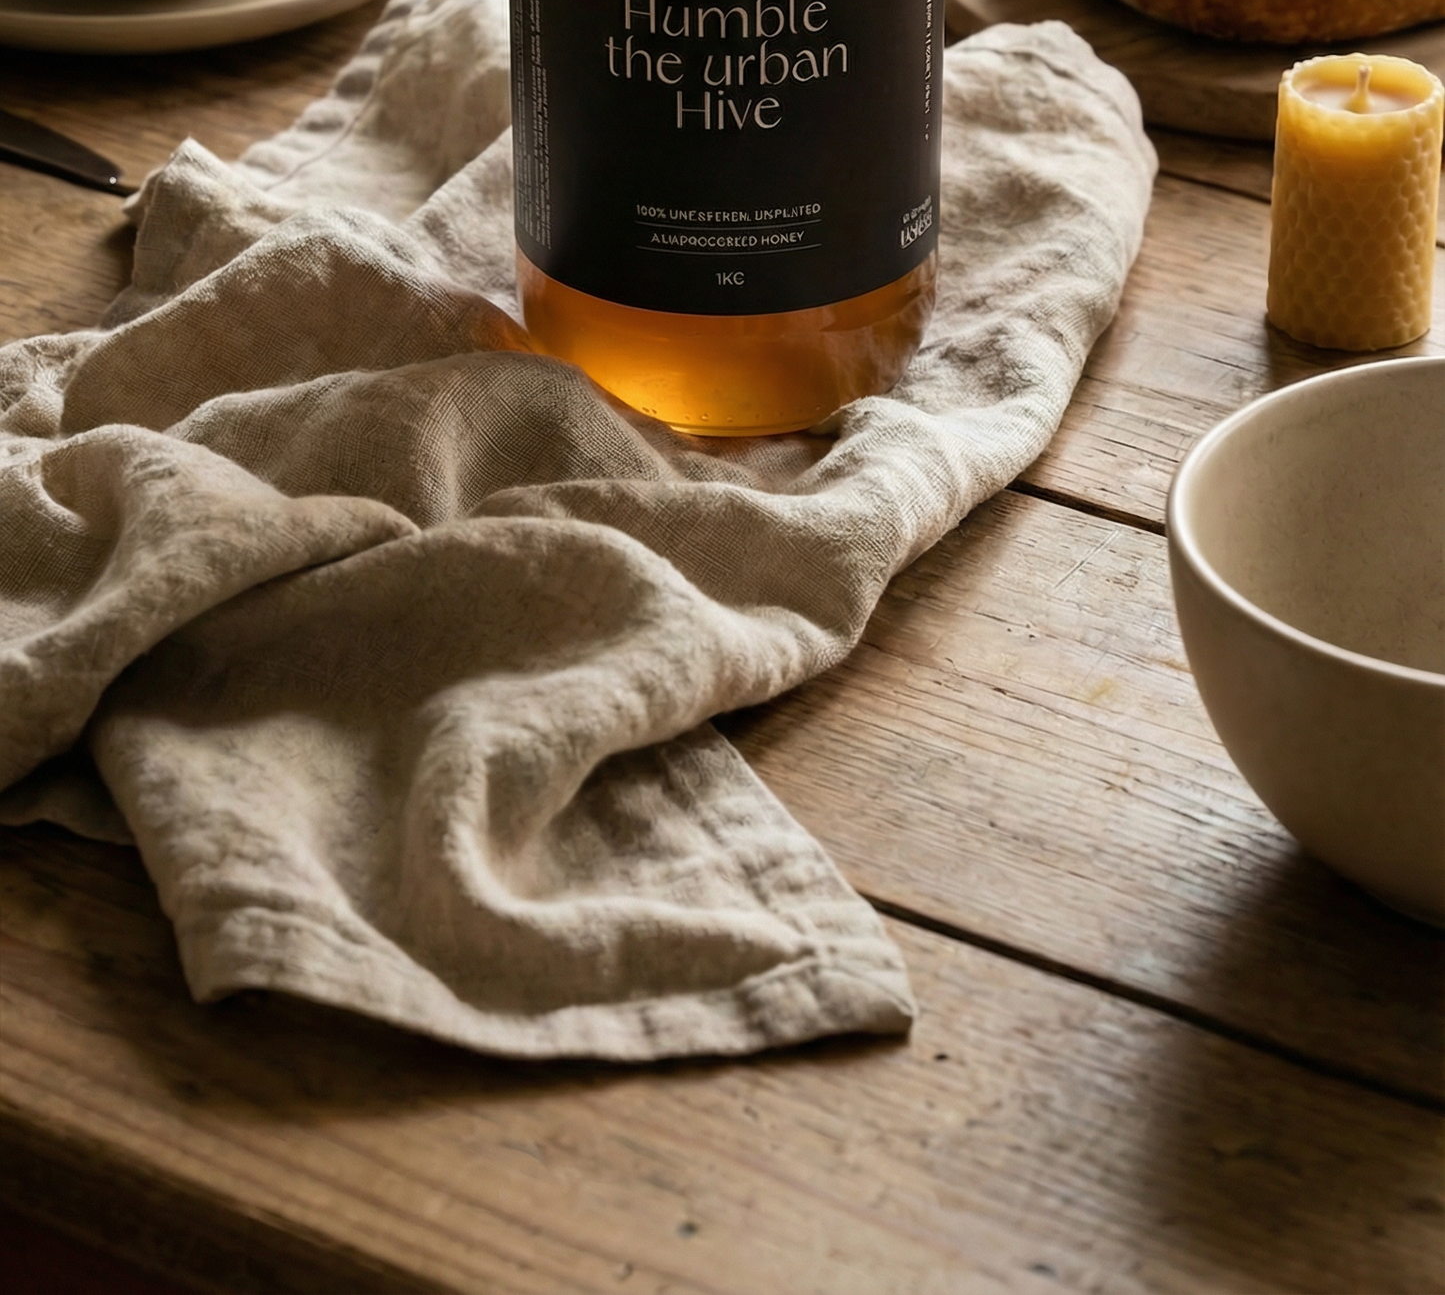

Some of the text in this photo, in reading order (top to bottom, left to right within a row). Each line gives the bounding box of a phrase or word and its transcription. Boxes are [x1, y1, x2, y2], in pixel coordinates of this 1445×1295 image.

[604, 35, 848, 86] the urban
[677, 90, 783, 130] Hive
[636, 204, 667, 219] 100%
[761, 231, 805, 245] HONEY
